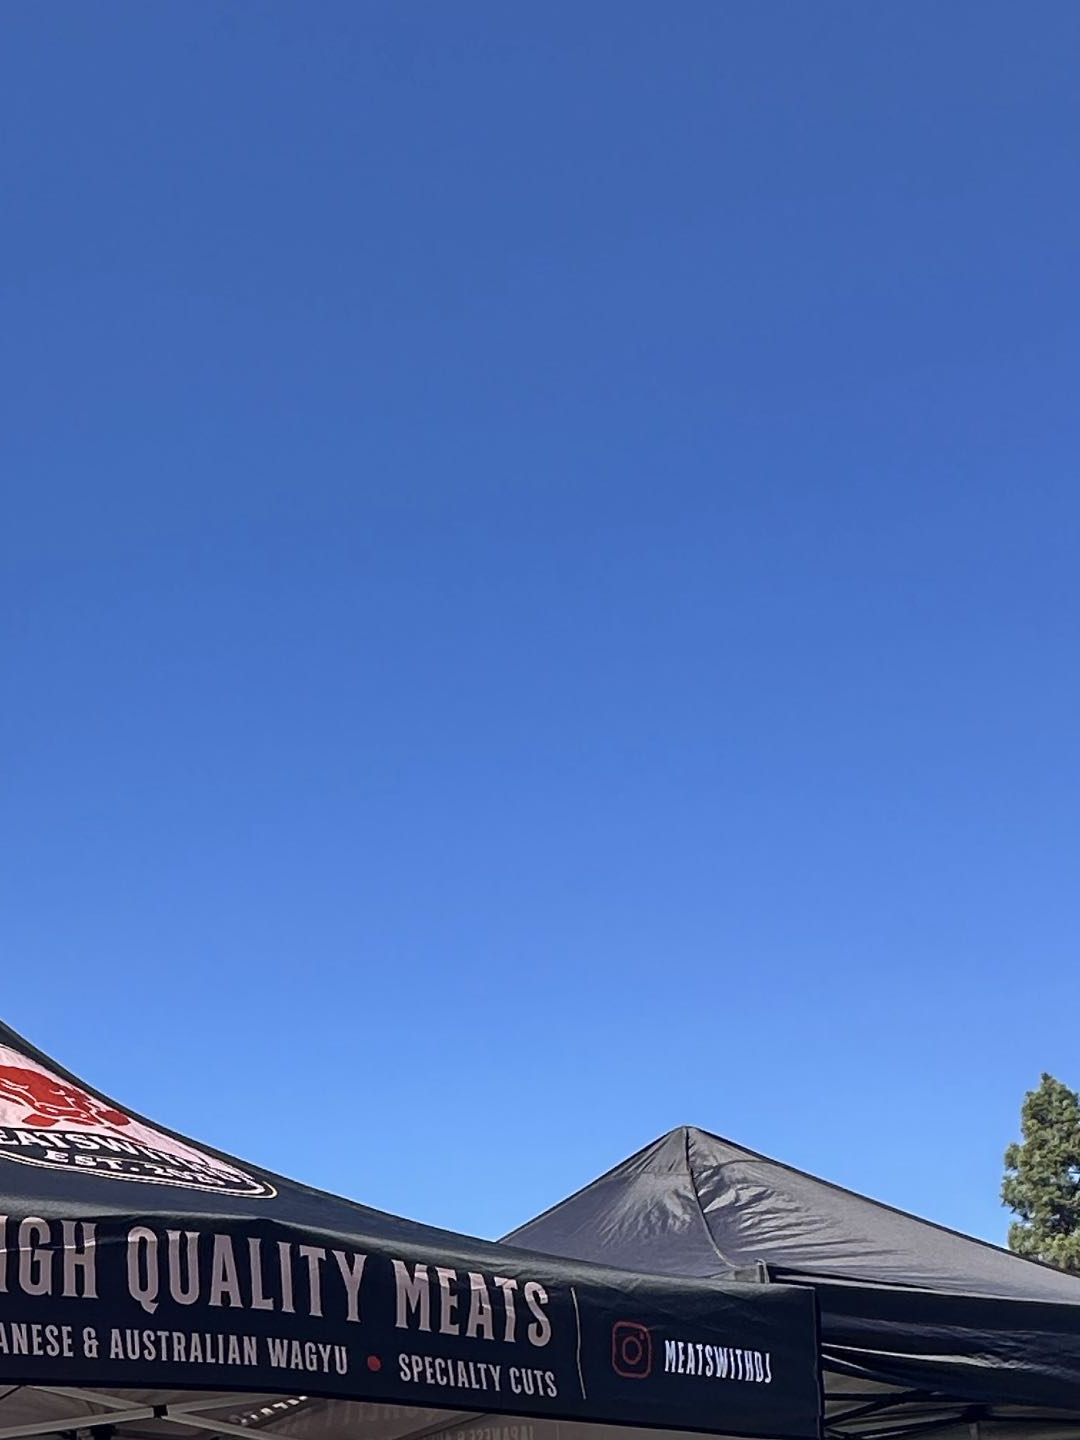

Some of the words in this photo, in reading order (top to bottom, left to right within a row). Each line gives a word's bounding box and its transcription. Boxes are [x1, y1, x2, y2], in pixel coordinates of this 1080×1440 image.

[126, 1225, 363, 1323] QUALITY
[394, 1258, 553, 1347] MEATS
[82, 1329, 99, 1358] &
[110, 1329, 259, 1367] AUSTRALIAN
[266, 1337, 350, 1376] WAGYU
[398, 1353, 502, 1394] SPECIALTY
[508, 1366, 560, 1399] CUTS
[664, 1339, 773, 1384] MEATSWITHDJ
